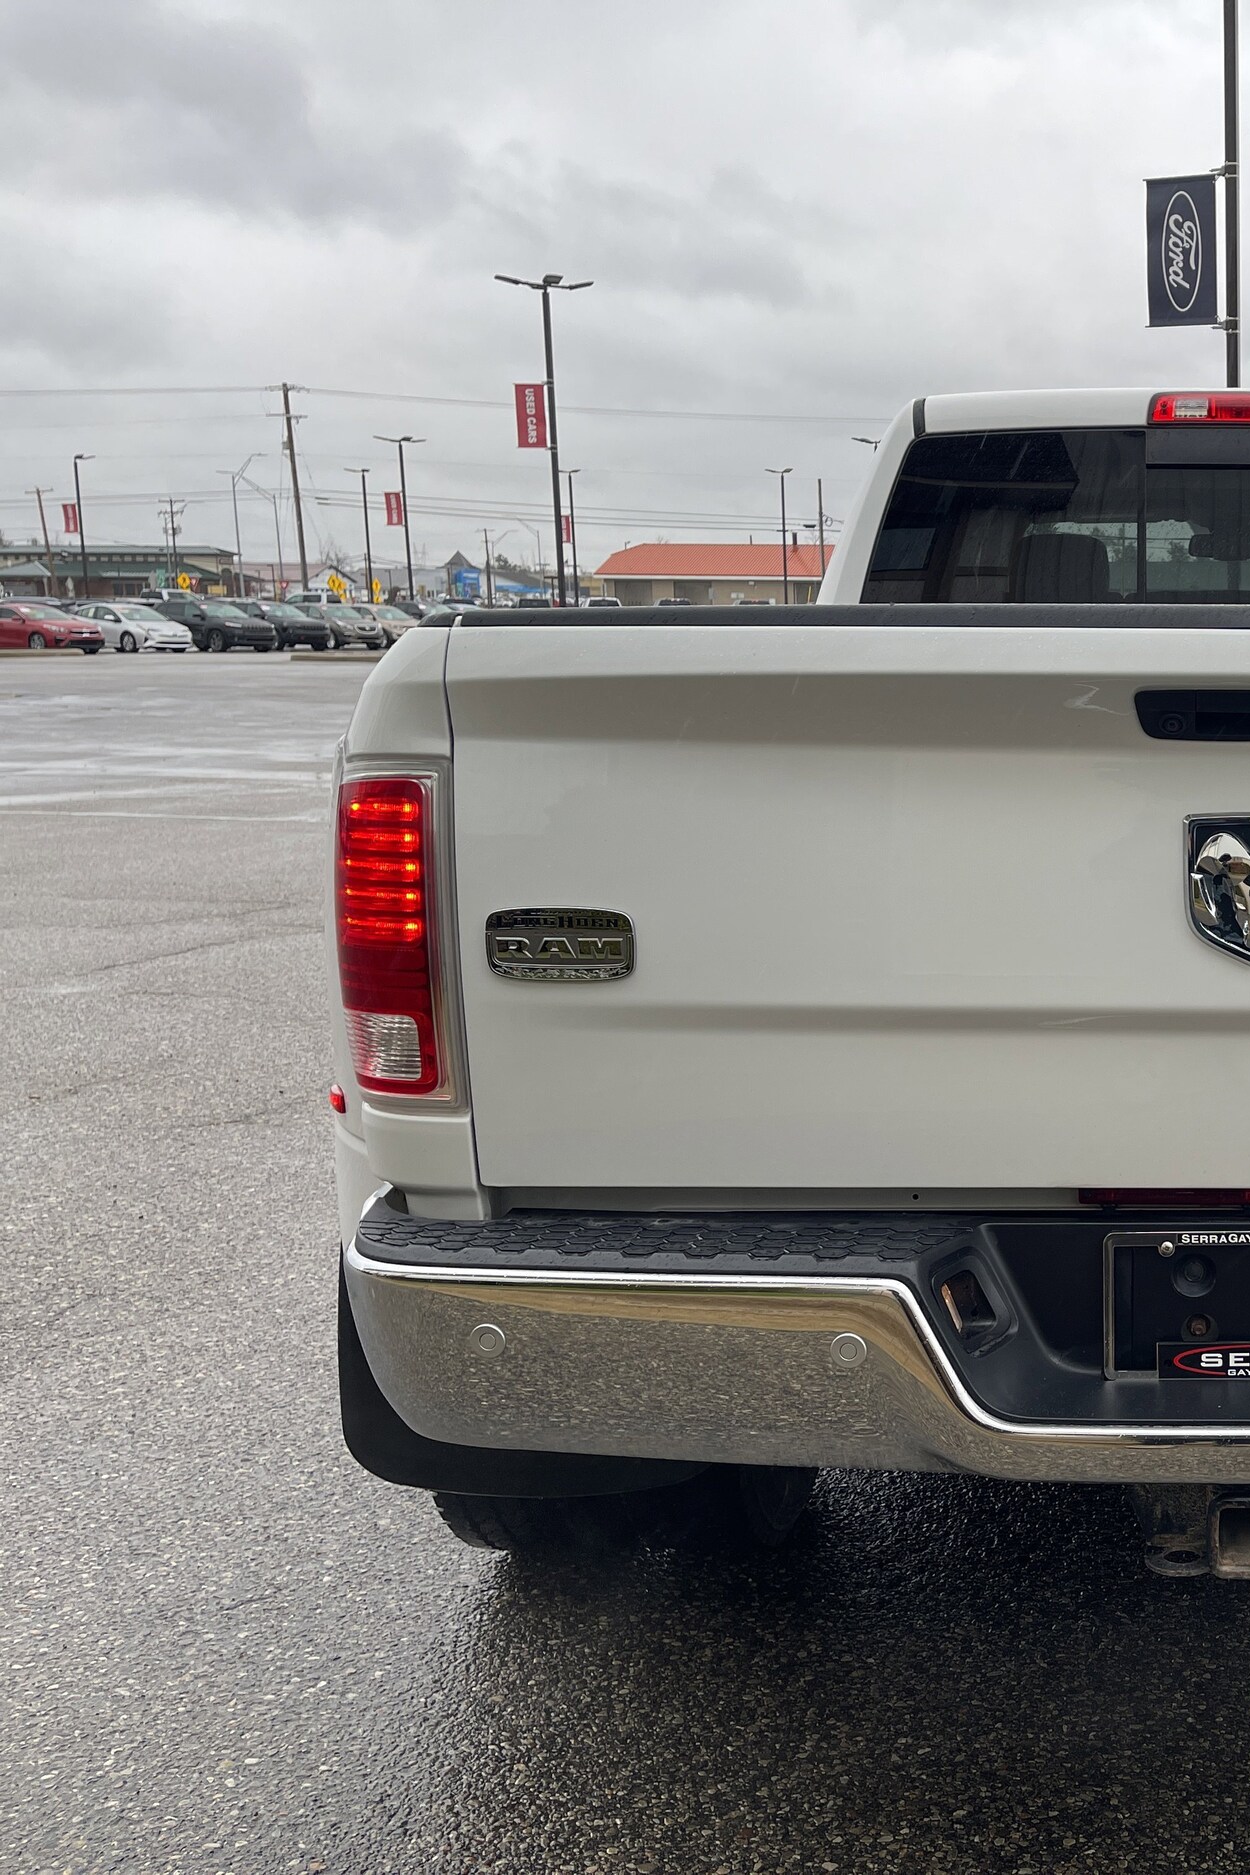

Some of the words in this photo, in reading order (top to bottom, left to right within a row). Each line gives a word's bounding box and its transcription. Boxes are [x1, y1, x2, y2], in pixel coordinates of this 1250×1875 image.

[1168, 213, 1198, 289] Ford
[525, 388, 536, 415] USED
[527, 417, 537, 444] CARS
[495, 936, 625, 960] RAM
